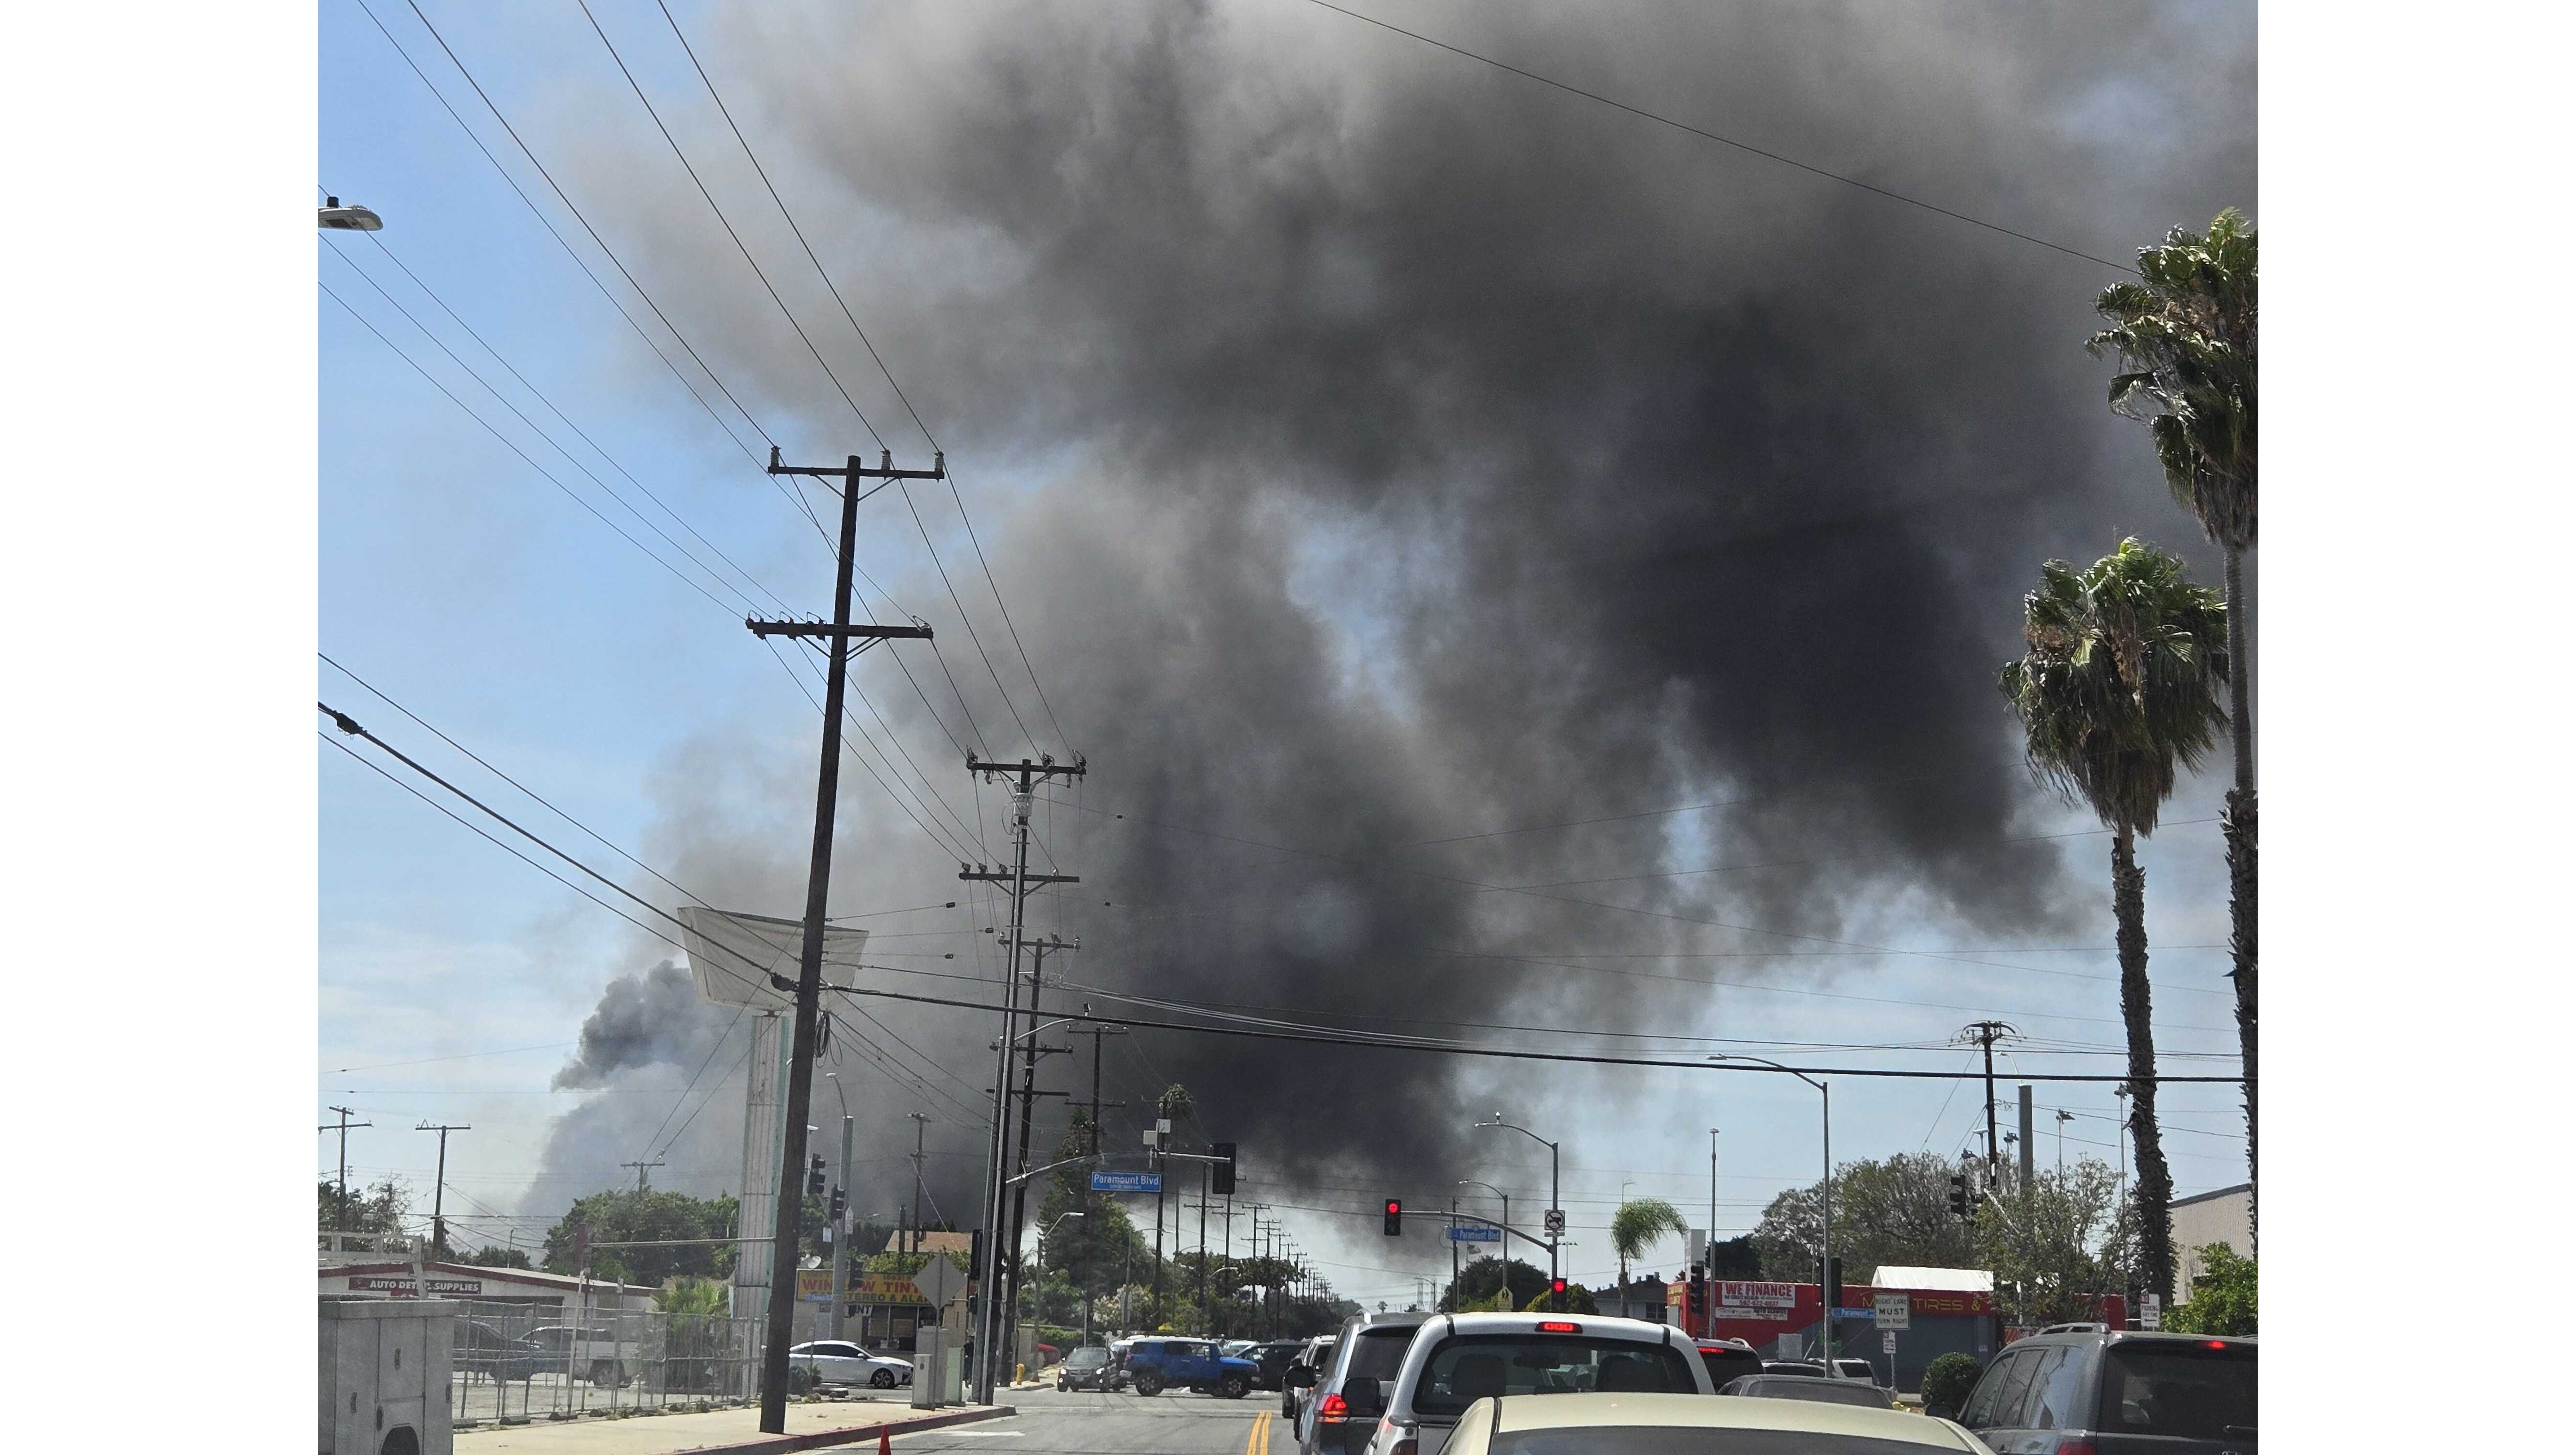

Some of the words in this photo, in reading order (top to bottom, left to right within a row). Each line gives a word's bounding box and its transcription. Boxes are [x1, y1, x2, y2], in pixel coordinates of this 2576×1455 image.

[1093, 1174, 1139, 1184] Paramount
[1141, 1175, 1159, 1185] Blvd
[1460, 1229, 1486, 1240] Paramount
[370, 1280, 396, 1289] AUTO
[433, 1282, 479, 1291] SUPPLIES
[802, 1279, 877, 1292] WINW
[1725, 1283, 1743, 1295] WE
[1745, 1283, 1793, 1297] FINANCE
[845, 1293, 885, 1301] TEREO
[889, 1294, 897, 1302] &
[1912, 1298, 1964, 1310] TIRES
[1971, 1300, 1980, 1311] &
